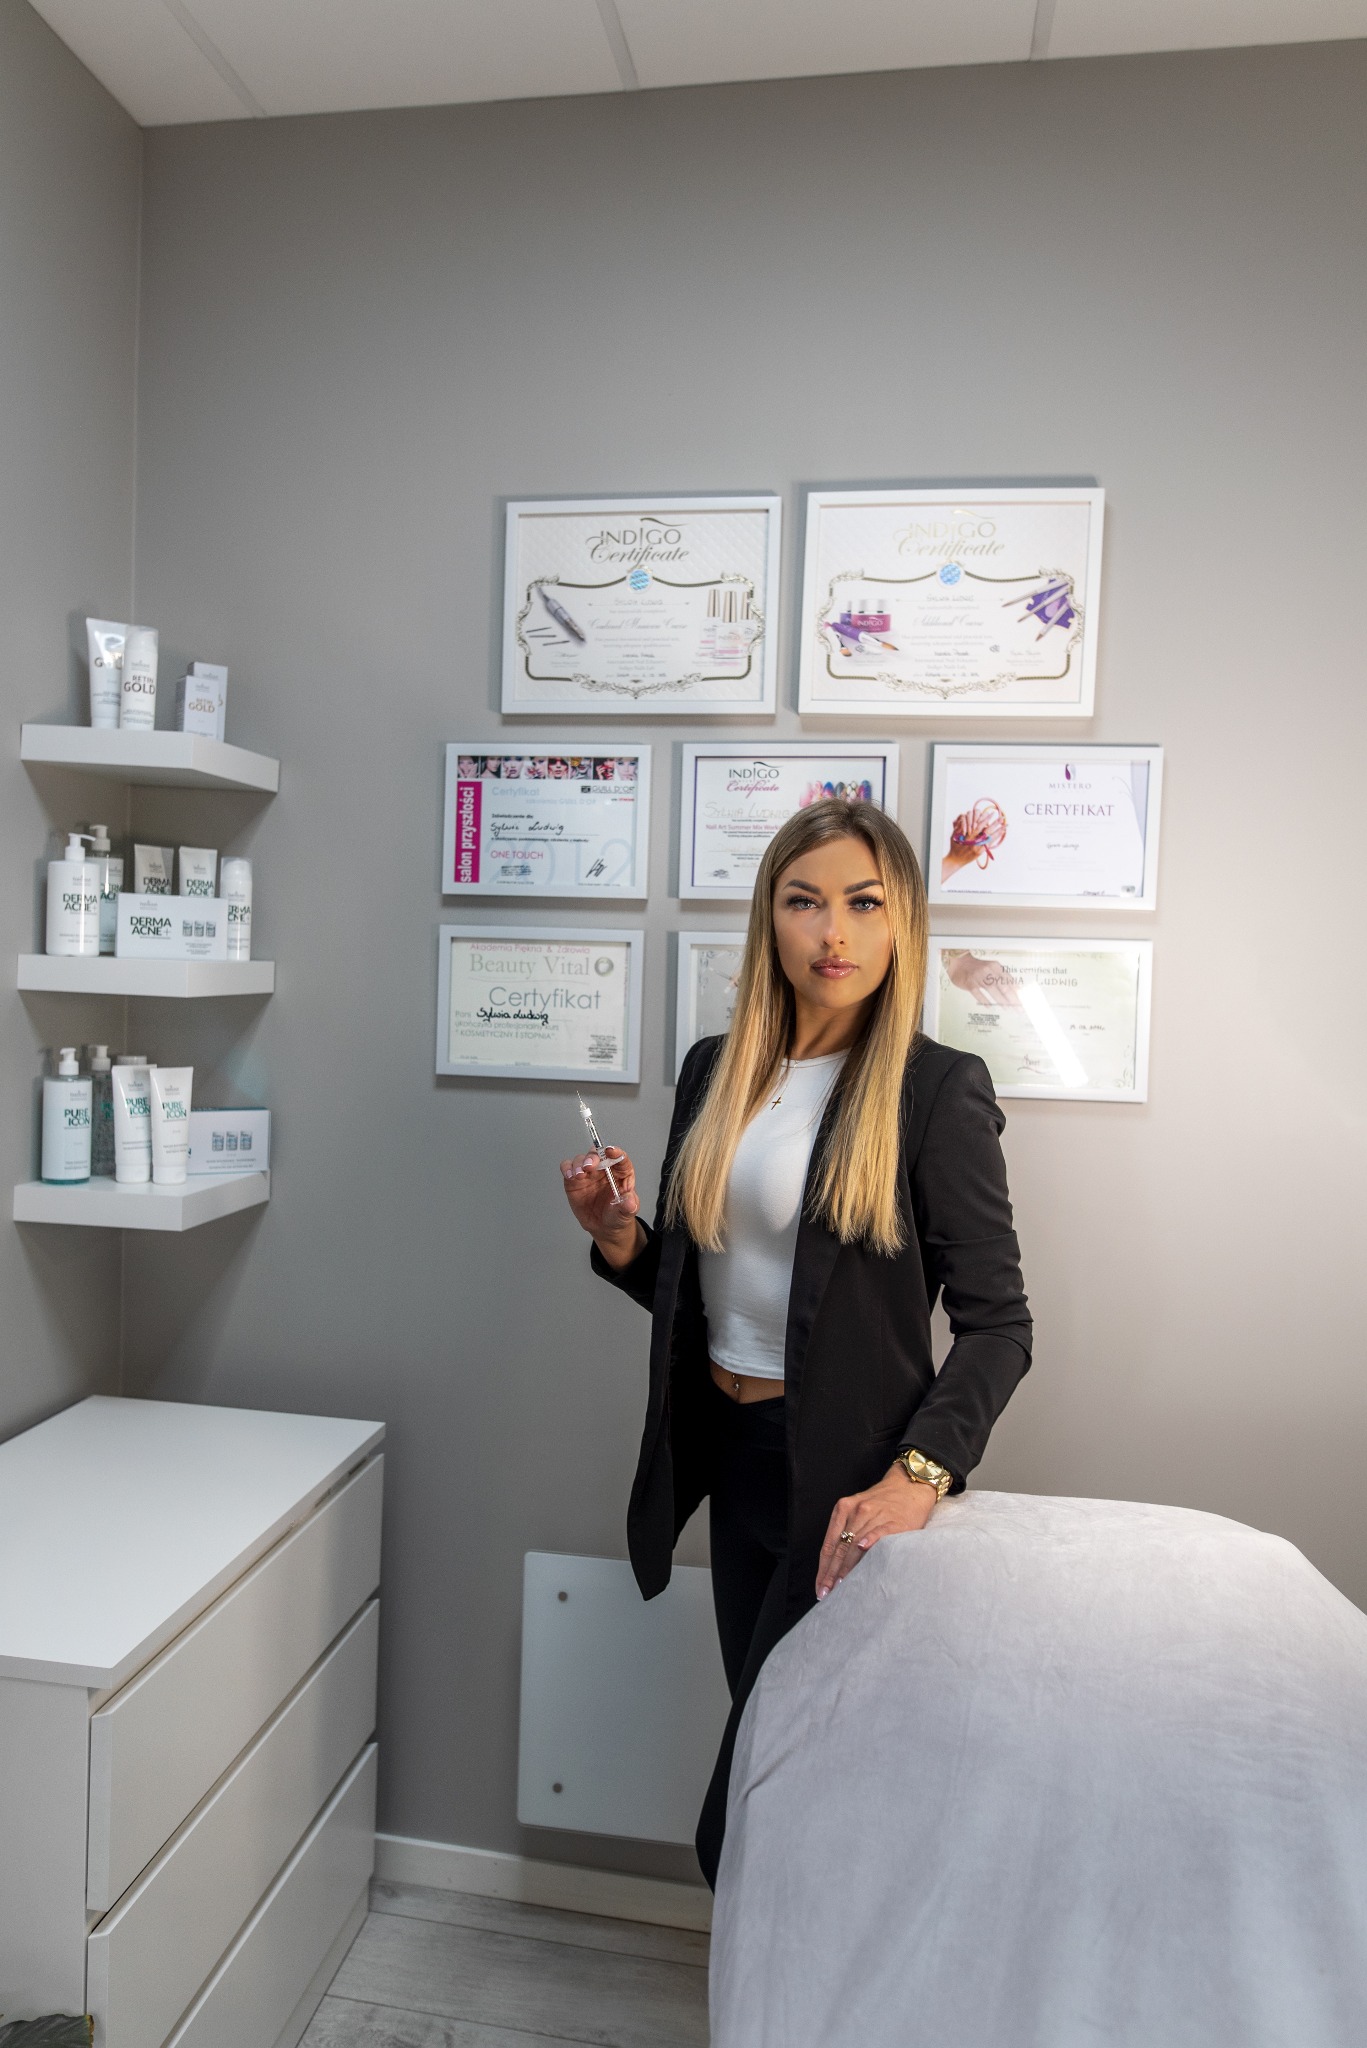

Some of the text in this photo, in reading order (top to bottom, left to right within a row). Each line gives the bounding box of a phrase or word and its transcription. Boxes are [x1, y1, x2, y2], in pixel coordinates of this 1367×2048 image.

[909, 519, 997, 539] INDIGO
[600, 527, 682, 546] INDIGO
[898, 536, 1006, 562] Certificate
[590, 543, 690, 572] Certificate
[123, 681, 156, 696] GOLD
[188, 702, 215, 713] GOLD
[728, 767, 780, 779] INDIGO
[726, 779, 780, 799] Certificate
[1023, 802, 1116, 817] CERTYFIKAT
[457, 786, 477, 883] salon przyszłości
[490, 850, 545, 860] ONE TOUCH
[186, 878, 214, 888] DERMA
[130, 916, 172, 928] DERMA
[470, 953, 591, 980] Beauty Vital
[1001, 965, 1068, 975] This certifies that
[982, 973, 1025, 986] SYLWIA
[489, 986, 601, 1016] Certyfikat
[476, 1006, 512, 1022] Sylwia
[125, 1097, 148, 1107] PURE
[162, 1100, 184, 1111] PURE
[64, 1108, 89, 1119] PURE
[166, 1109, 187, 1119] ICON
[68, 1116, 90, 1127] ICON
